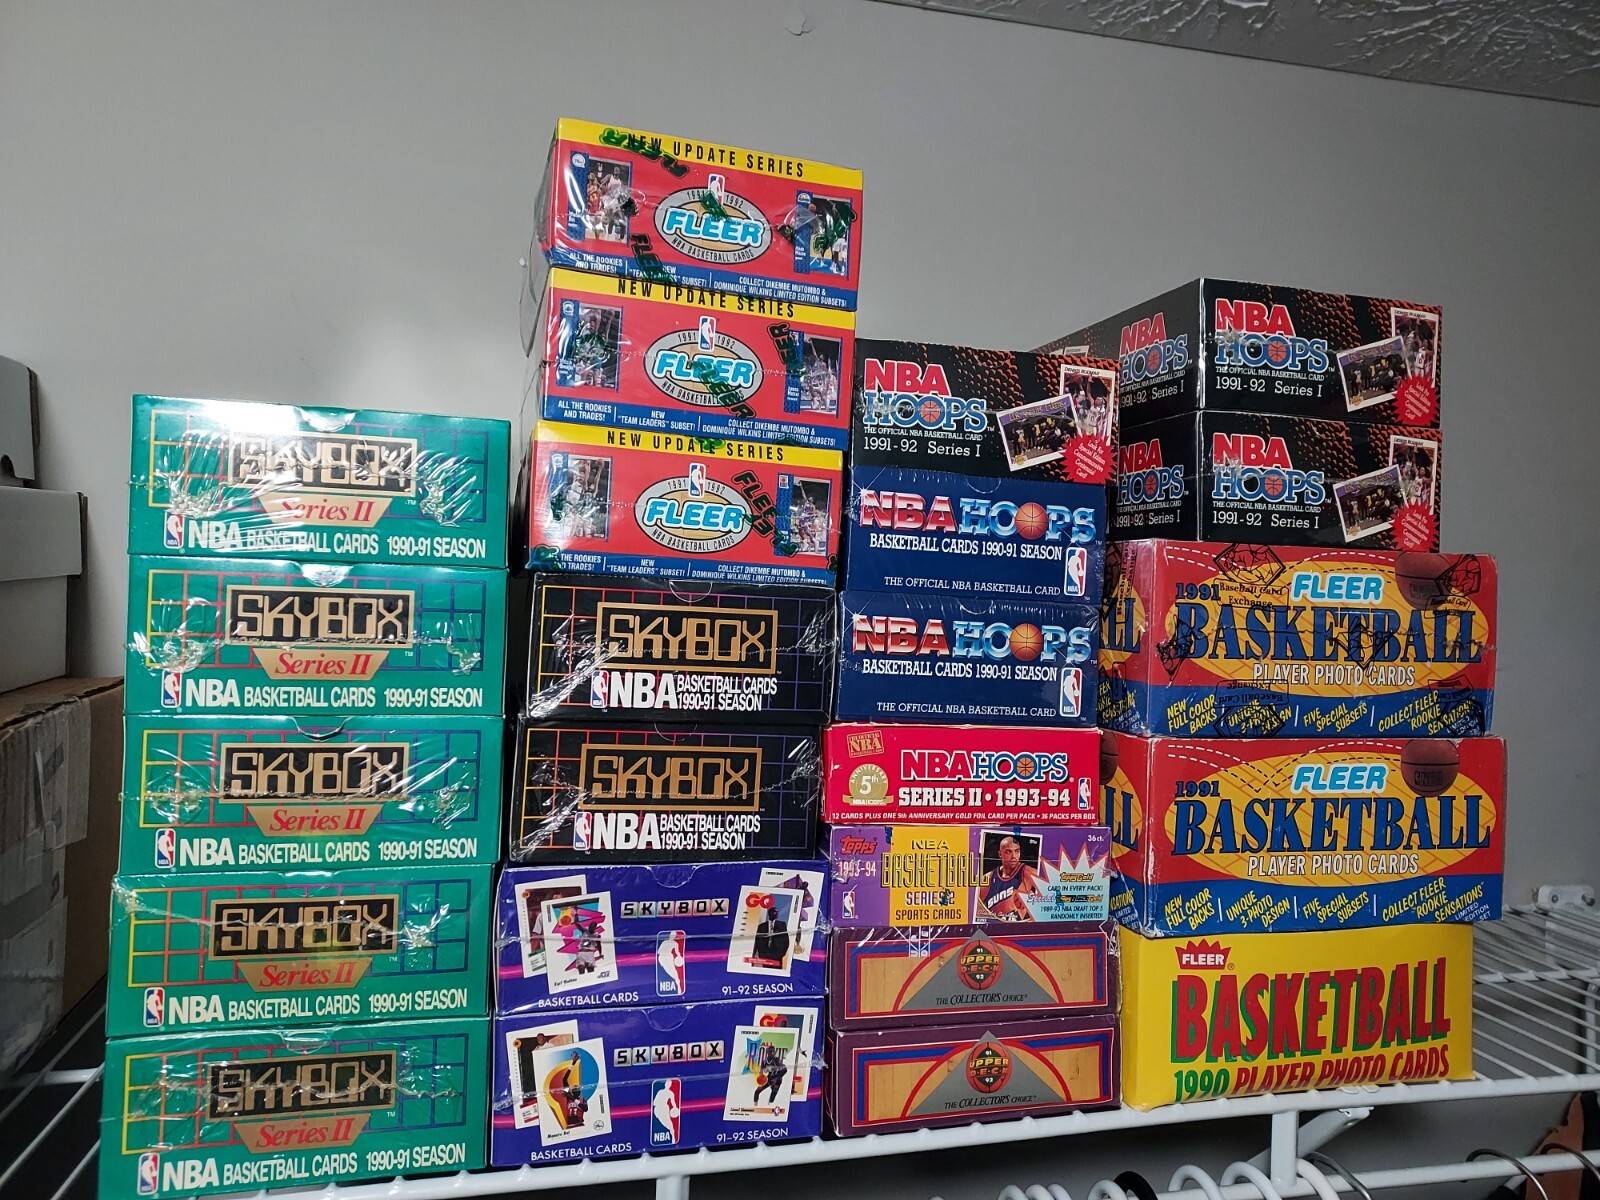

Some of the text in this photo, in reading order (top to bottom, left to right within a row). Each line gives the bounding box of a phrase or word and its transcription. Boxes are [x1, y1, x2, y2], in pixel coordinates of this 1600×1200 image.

[628, 133, 803, 177] NEW UPDATE SERIES
[663, 208, 763, 247] FLEER
[618, 278, 795, 317] NEW UPDATE SERIES
[1216, 298, 1295, 337] NBA
[1215, 332, 1328, 372] HOOPS
[865, 359, 951, 397] NBA
[1274, 381, 1314, 397] Series
[1318, 385, 1322, 397] I
[558, 401, 611, 413] ALL THE ROOKIES
[563, 410, 605, 421] AND TRADES!
[863, 393, 986, 433] HOOPS
[607, 431, 784, 461] NEW UPDATE SERIES
[910, 429, 922, 437] NBA
[924, 431, 962, 439] BASKETBALL
[965, 433, 982, 441] CARD
[928, 441, 970, 457] Series
[976, 445, 980, 457] I
[1213, 433, 1292, 469] NBA
[1212, 466, 1326, 504] HOOPS
[643, 498, 745, 534] FLEER
[1271, 515, 1311, 529] Series
[1314, 517, 1319, 528] I
[334, 533, 485, 558] CARDS 1990-91 SEASON
[652, 529, 734, 551] NBA BASKETBALL CARDS
[870, 533, 1062, 560] BASKETBALL CARDS 1990-91 SEASON
[885, 577, 1060, 595] THE OFFICIAL NBA BASKETBALL CARD
[1291, 572, 1383, 603] FLEER
[237, 595, 403, 638] SKYBOX
[609, 614, 765, 662] SKYBOX
[275, 652, 372, 674] Series II
[863, 659, 1057, 681] BASKETBALL CARDS 1990-91 SEASON
[1253, 663, 1415, 686] PLAYER PHOTO CARDS
[185, 679, 482, 707] NBA BASKETBALL CARDS 1990-91 SEASON
[609, 672, 777, 709] NBA BASKETBALL CARDS
[678, 694, 761, 711] 1990-91 SEASON
[231, 752, 397, 794] SKYBOX
[592, 756, 748, 798] SKYBOX
[1175, 763, 1388, 798] 1991 FLEER
[899, 788, 1071, 807] SERIES II 1993-94
[270, 809, 367, 831] Series II
[594, 813, 760, 849] NBA BASKETBALL CARDS
[1171, 795, 1490, 856] BASKETBALL
[179, 838, 477, 866] NBA BASKETBALL CARDS 1990-91 SEASON
[661, 833, 745, 850] 1990-91 SEASON
[1248, 853, 1418, 877] PLAYER PHOTO CARDS
[622, 899, 728, 918] SKYBOX
[896, 909, 961, 920] SPORTS CARDS
[1225, 890, 1257, 919] UNIQUE
[1240, 893, 1273, 928] 3-PHOTO
[1262, 897, 1290, 927] DESIGN
[1303, 899, 1320, 918] FIVE
[1316, 892, 1348, 924] SPECIAL
[1337, 891, 1369, 923] SUBSETS
[221, 904, 388, 949] SKYBOX
[259, 963, 355, 987] Series II
[961, 956, 1000, 964] UPPER
[1182, 954, 1224, 966] FLEER
[169, 988, 467, 1024] NBA BASKETBALL CARDS 1990-91 SEASON
[538, 984, 793, 1008] BASKETBALL CARDS 91-92 SEASON
[1171, 957, 1451, 1063] BASKETBALL
[615, 1041, 723, 1066] SKYBOX
[1175, 1044, 1448, 1103] 1990 PLAYER PHOTO CARDS
[531, 1129, 789, 1161] BASKETBALL CARDS 91-92 SEASON
[163, 1143, 465, 1191] NBA BASKETBALL CARDS 1990-91 SEASON
